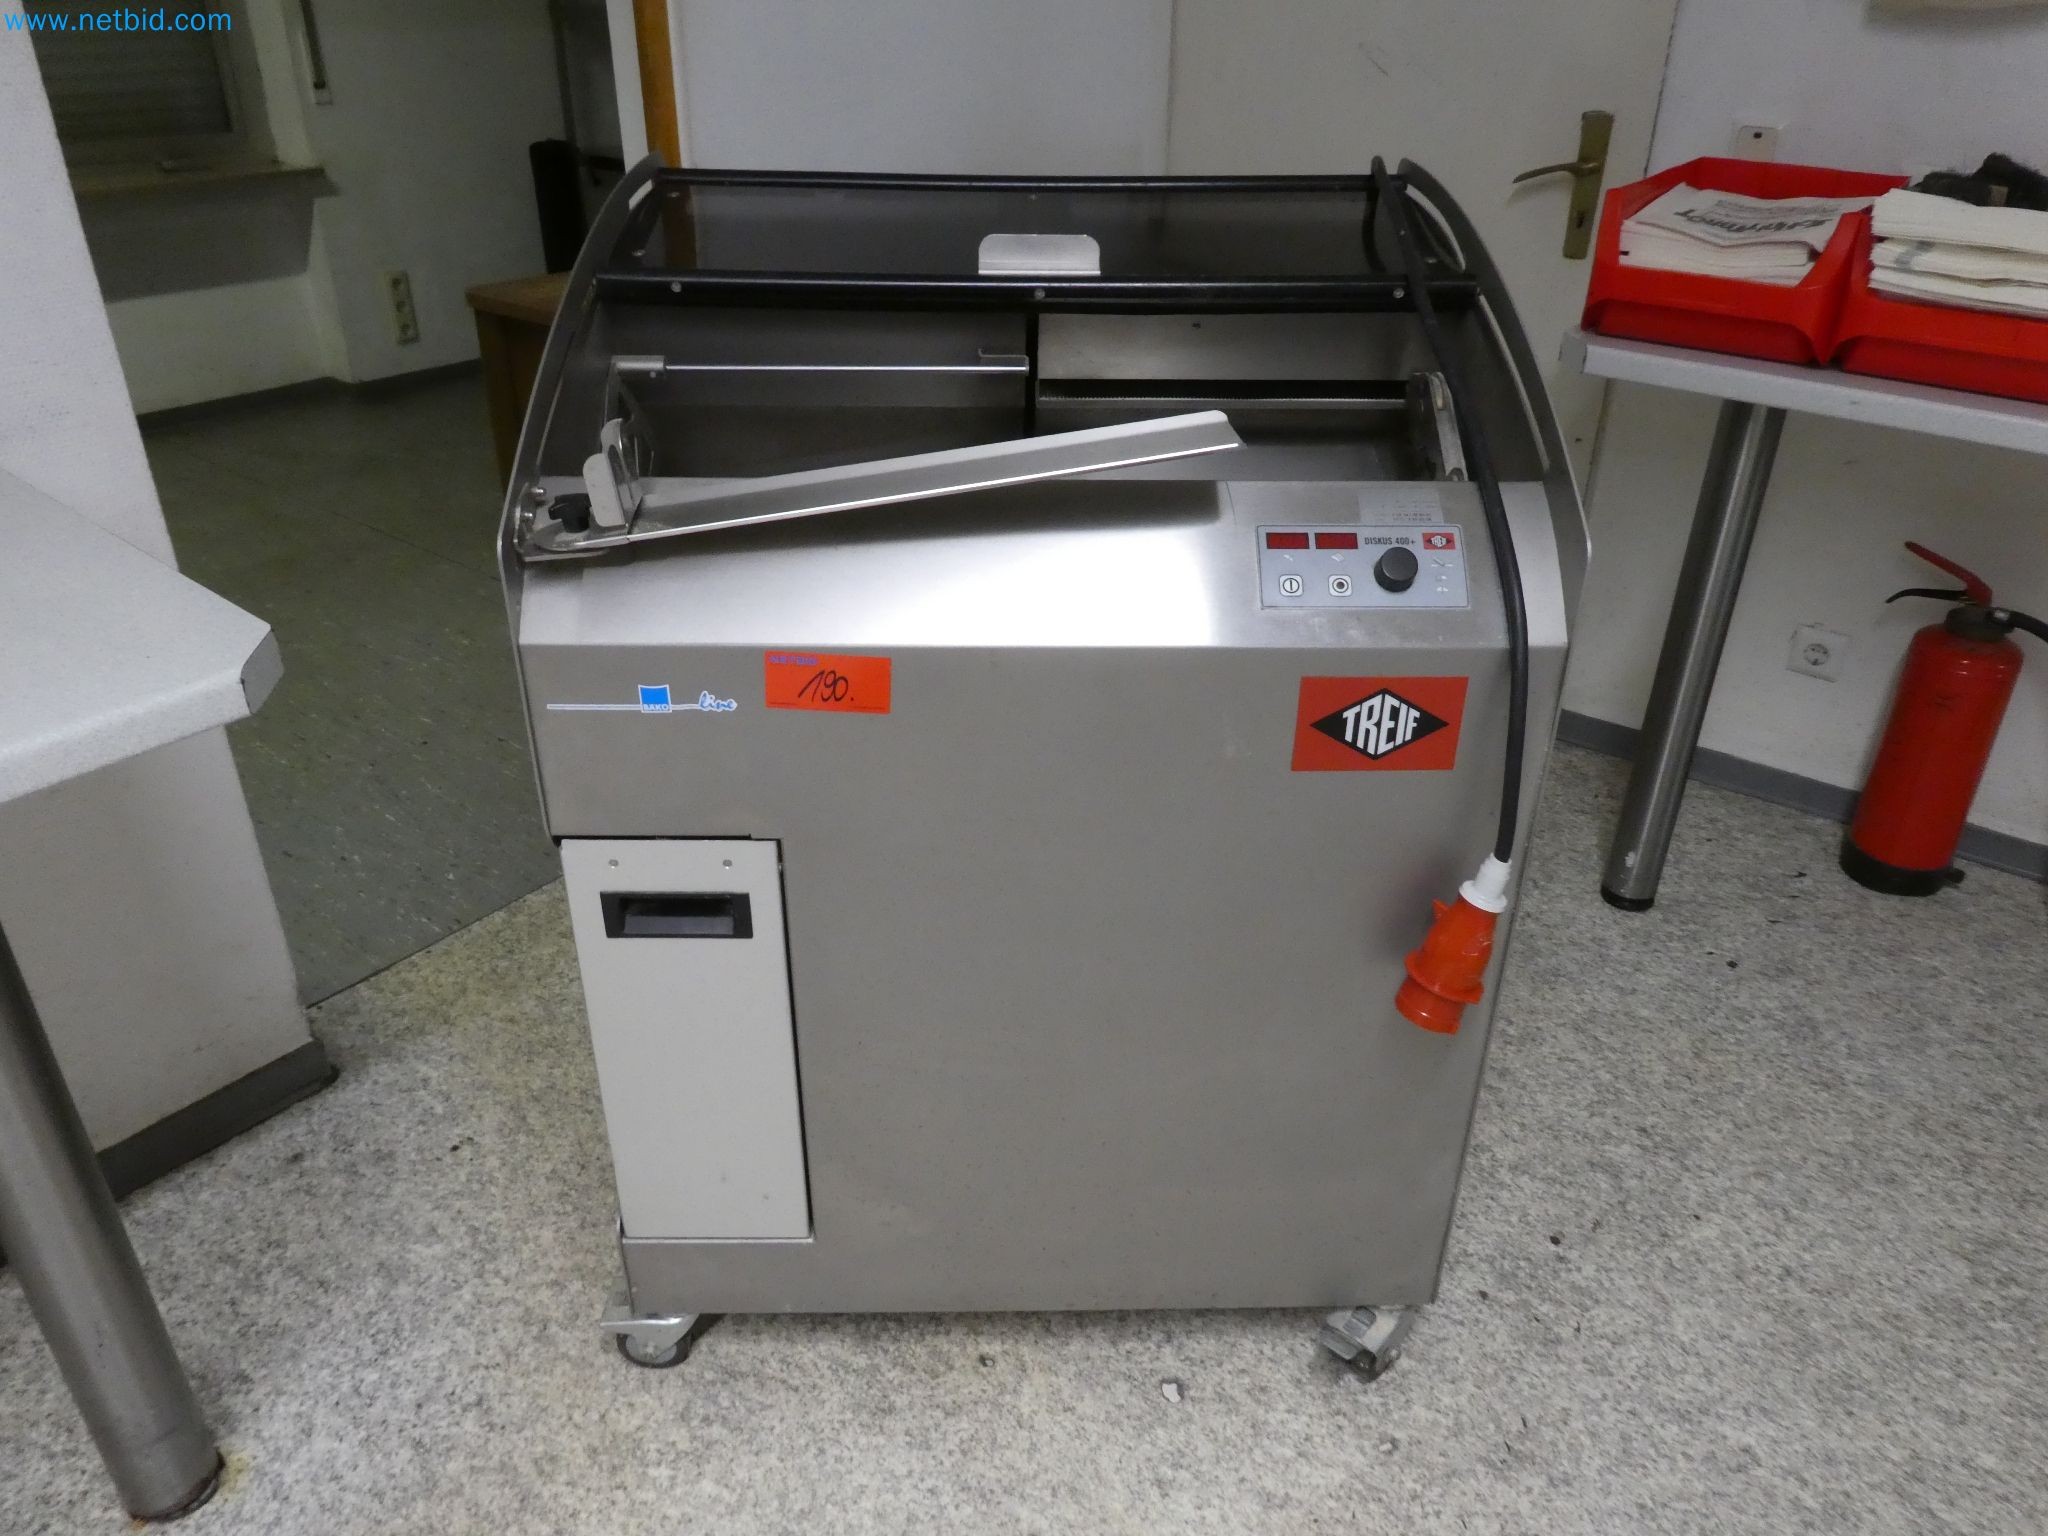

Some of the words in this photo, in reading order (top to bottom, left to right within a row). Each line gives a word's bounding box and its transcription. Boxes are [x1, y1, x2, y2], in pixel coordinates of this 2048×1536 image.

[1364, 536, 1393, 546] DISKUS
[700, 690, 738, 712] line
[1342, 693, 1420, 756] TREIF
